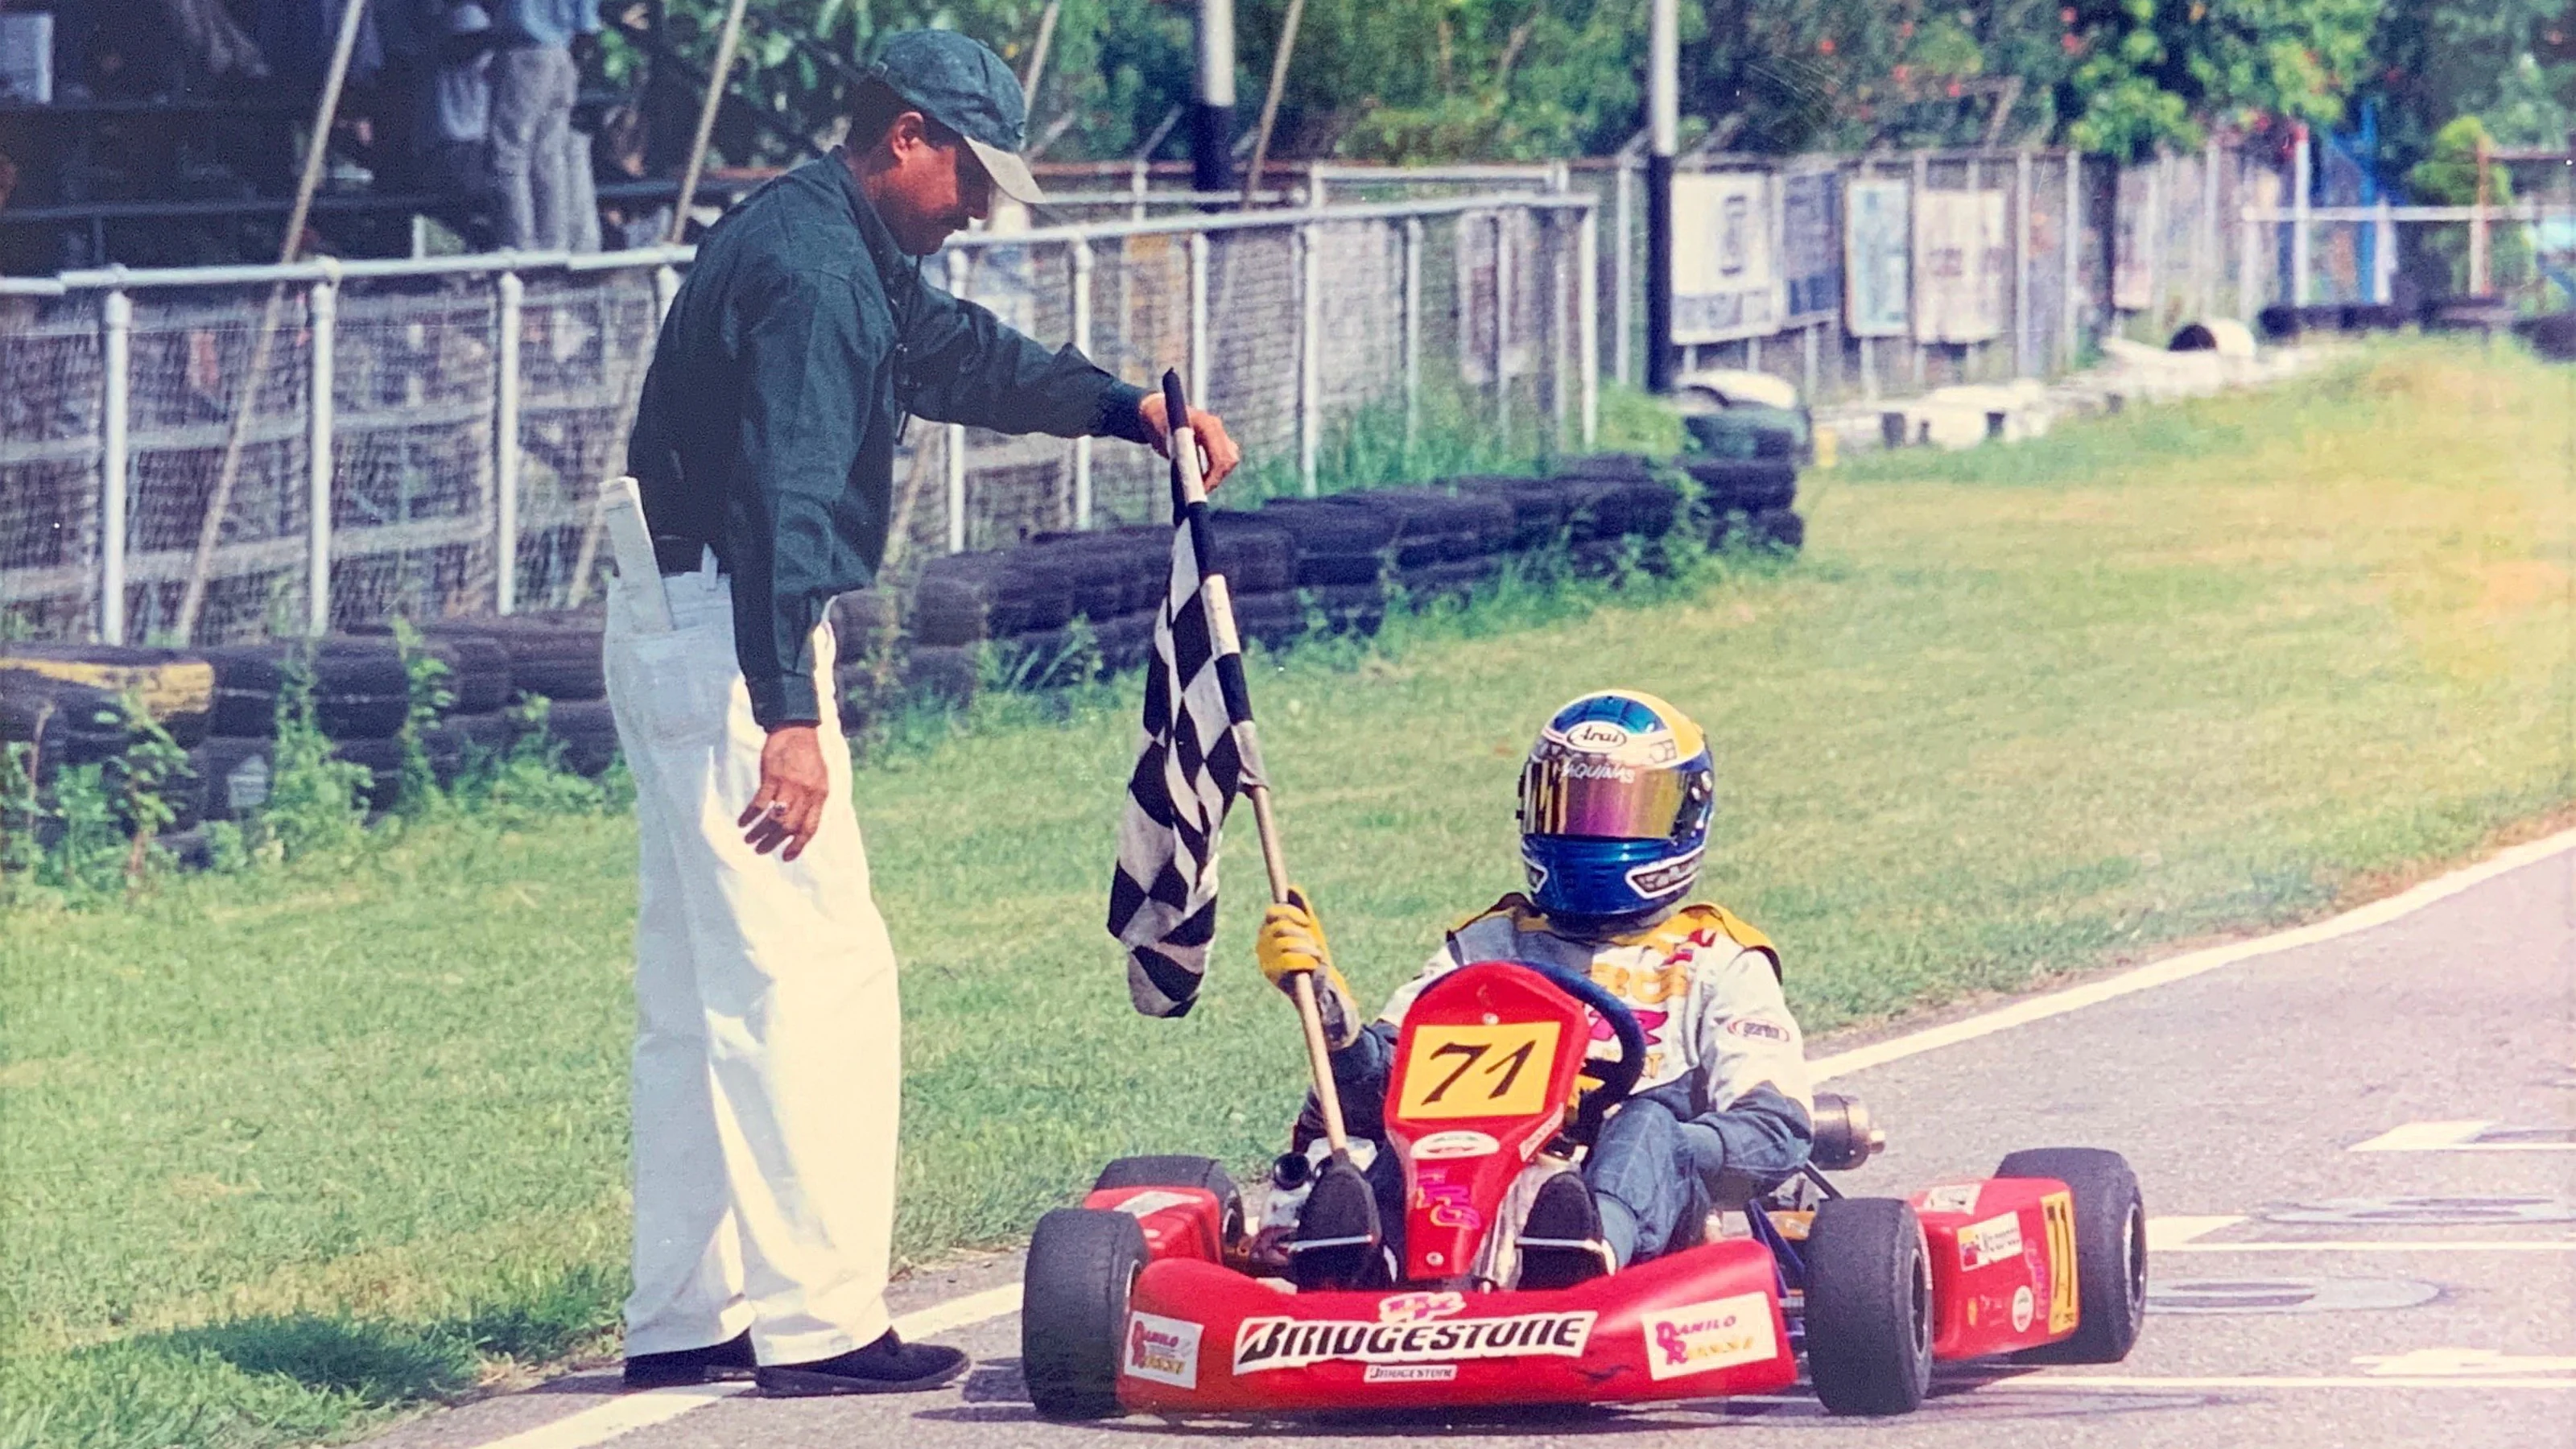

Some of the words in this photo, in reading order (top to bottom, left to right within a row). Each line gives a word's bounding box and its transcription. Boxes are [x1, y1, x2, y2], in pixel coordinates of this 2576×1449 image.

[1580, 725, 1619, 742] Arai
[1421, 1039, 1537, 1106] 71
[2046, 1200, 2073, 1308] 71
[1238, 1318, 1584, 1364] BRIDGESTONE
[1369, 1368, 1452, 1379] BRIDGESTONE
